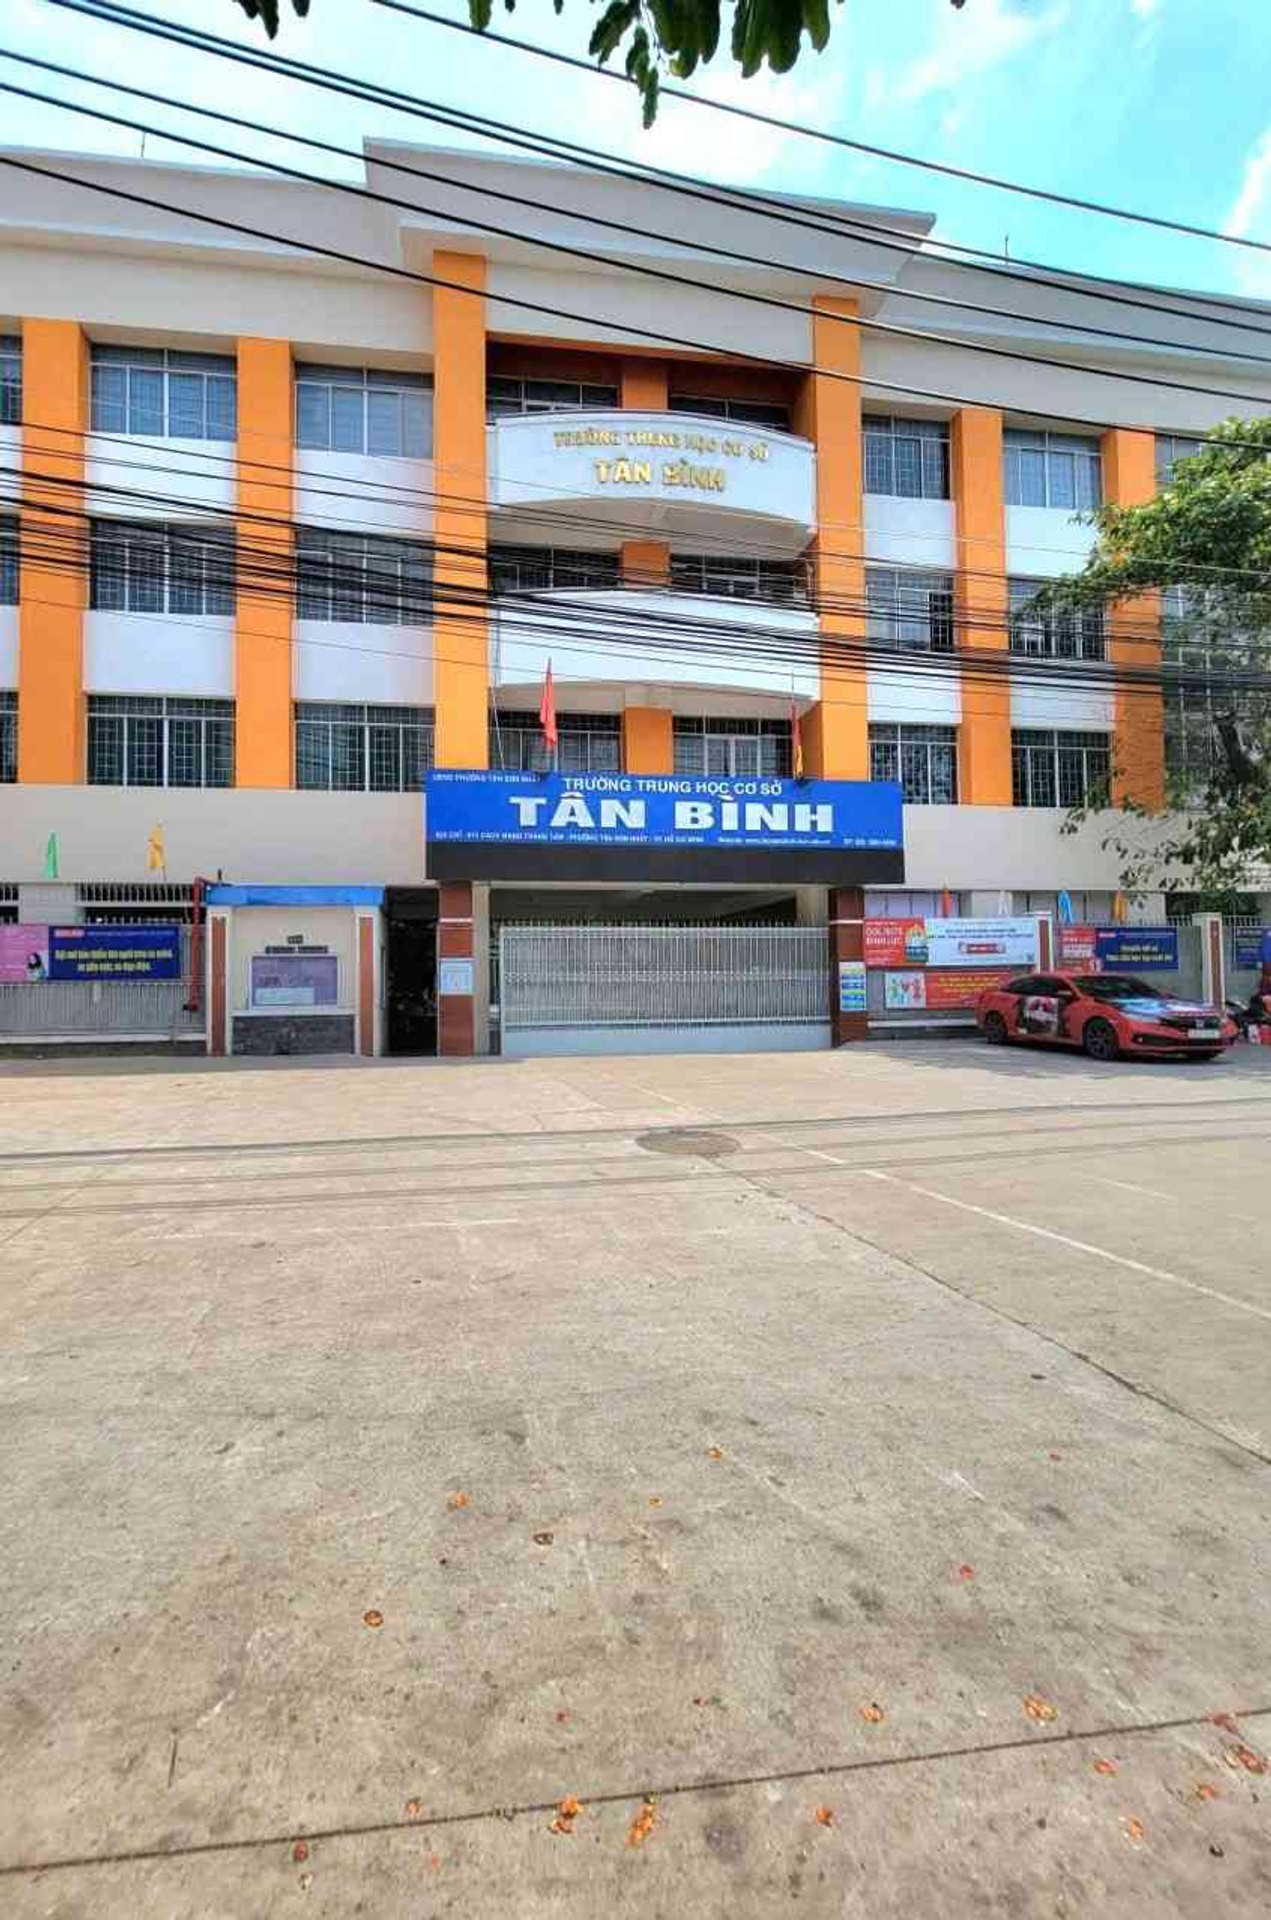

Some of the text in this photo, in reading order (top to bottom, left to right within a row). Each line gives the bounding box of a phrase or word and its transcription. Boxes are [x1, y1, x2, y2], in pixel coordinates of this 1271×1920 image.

[595, 454, 726, 491] TÂN BÌNH
[565, 776, 782, 796] TRƯỜNG TRUNG HỌC CƠ SỞ
[510, 791, 833, 832] TÂN BÌNH
